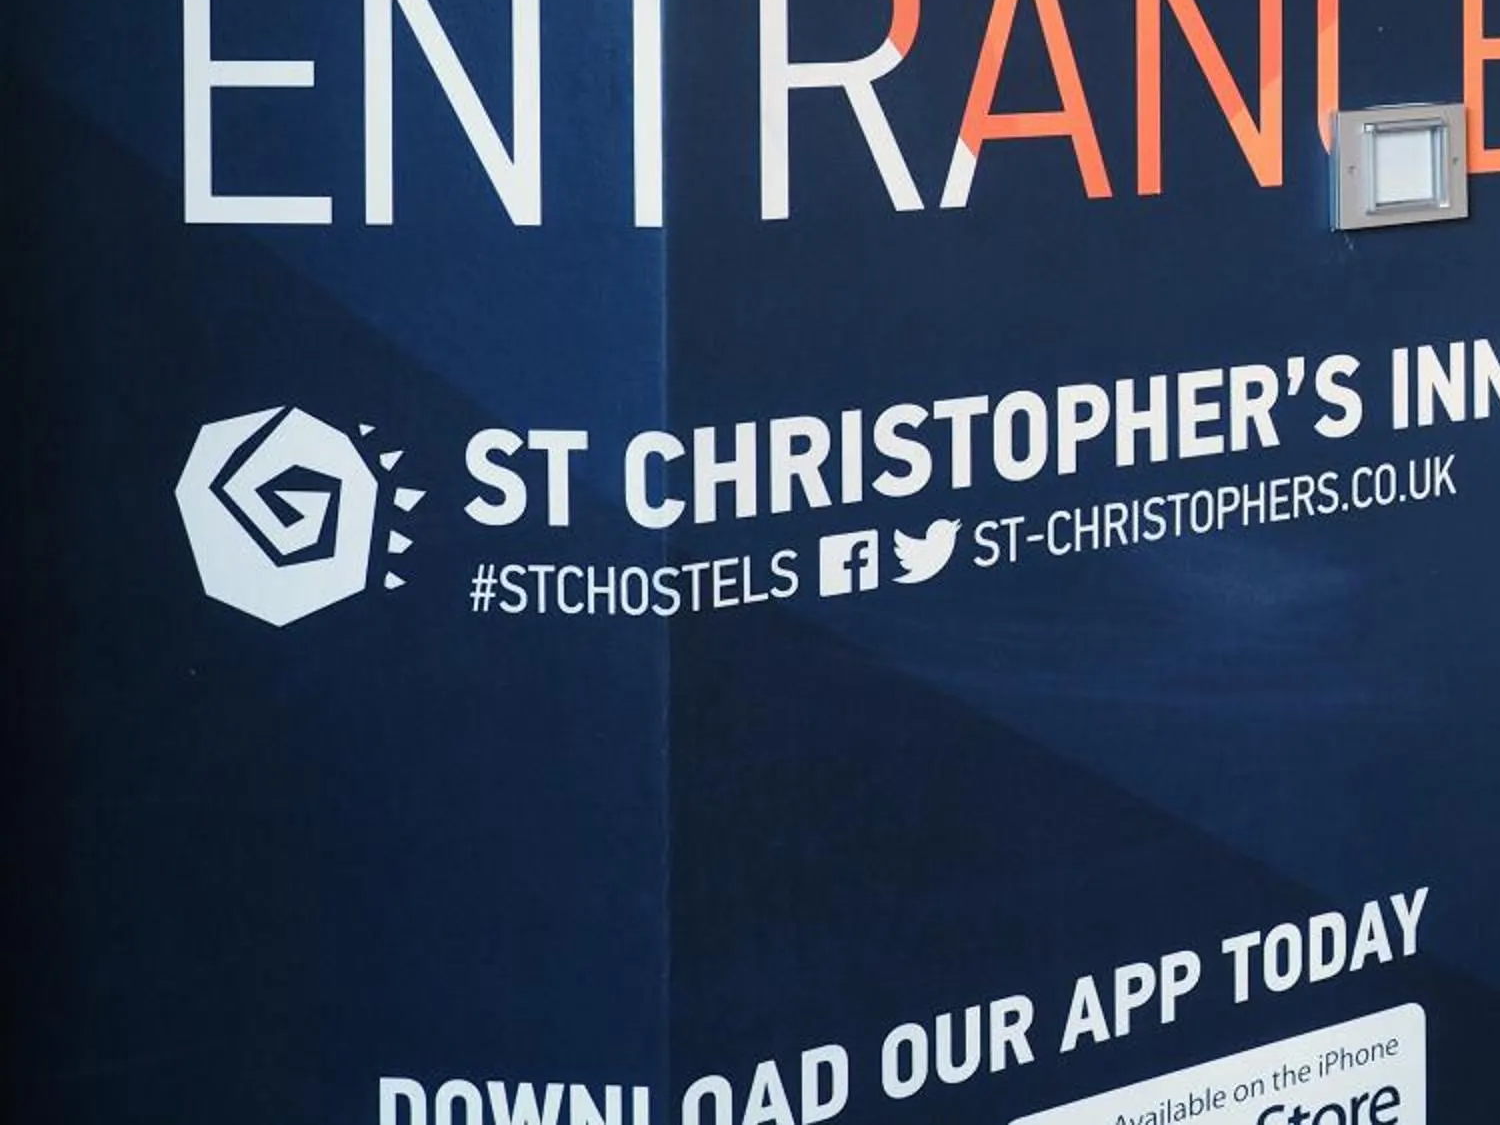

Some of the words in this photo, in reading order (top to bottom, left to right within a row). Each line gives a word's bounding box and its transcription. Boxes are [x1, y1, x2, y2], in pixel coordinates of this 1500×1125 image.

[464, 428, 589, 528] ST
[469, 550, 800, 617] #STCHOSTELS
[972, 454, 1458, 568] ST-CHRISTOPHERS.CO.UK
[881, 993, 1036, 1100] OUR
[1058, 949, 1202, 1054] APP
[1221, 886, 1430, 1005] TODAY
[1233, 1078, 1265, 1102] on
[1272, 1064, 1311, 1091] the
[1318, 1037, 1400, 1078] iPhone
